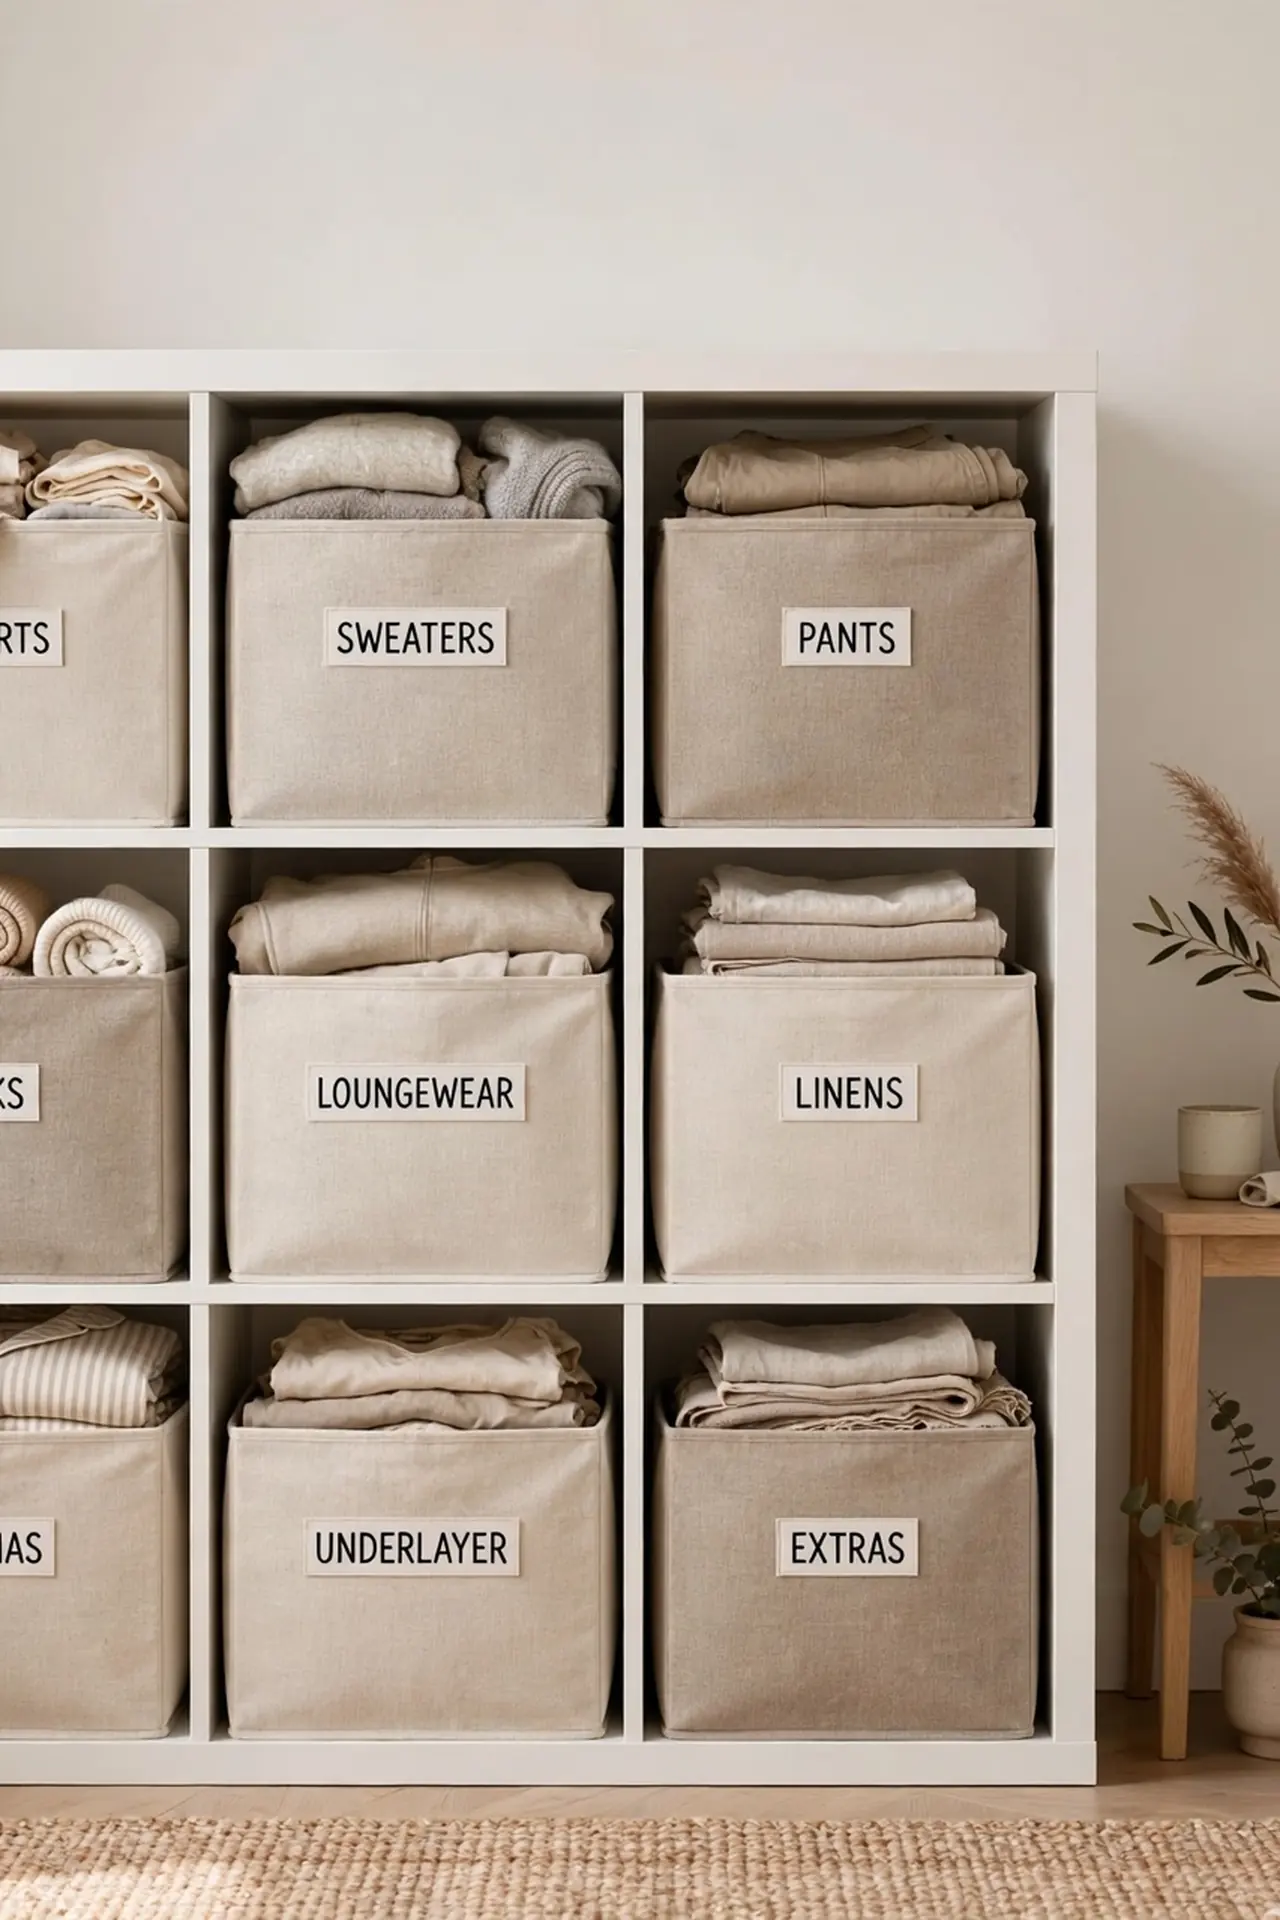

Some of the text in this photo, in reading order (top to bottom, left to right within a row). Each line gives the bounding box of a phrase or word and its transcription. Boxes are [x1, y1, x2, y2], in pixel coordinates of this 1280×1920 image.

[338, 622, 494, 654] SWEATERS
[800, 622, 895, 654] PANTS
[319, 1077, 513, 1109] LOUNGEWEAR
[797, 1077, 902, 1109] LINENS
[0, 1532, 42, 1564] AS
[317, 1532, 507, 1564] UNDERLAYER
[792, 1532, 904, 1564] EXTRAS
